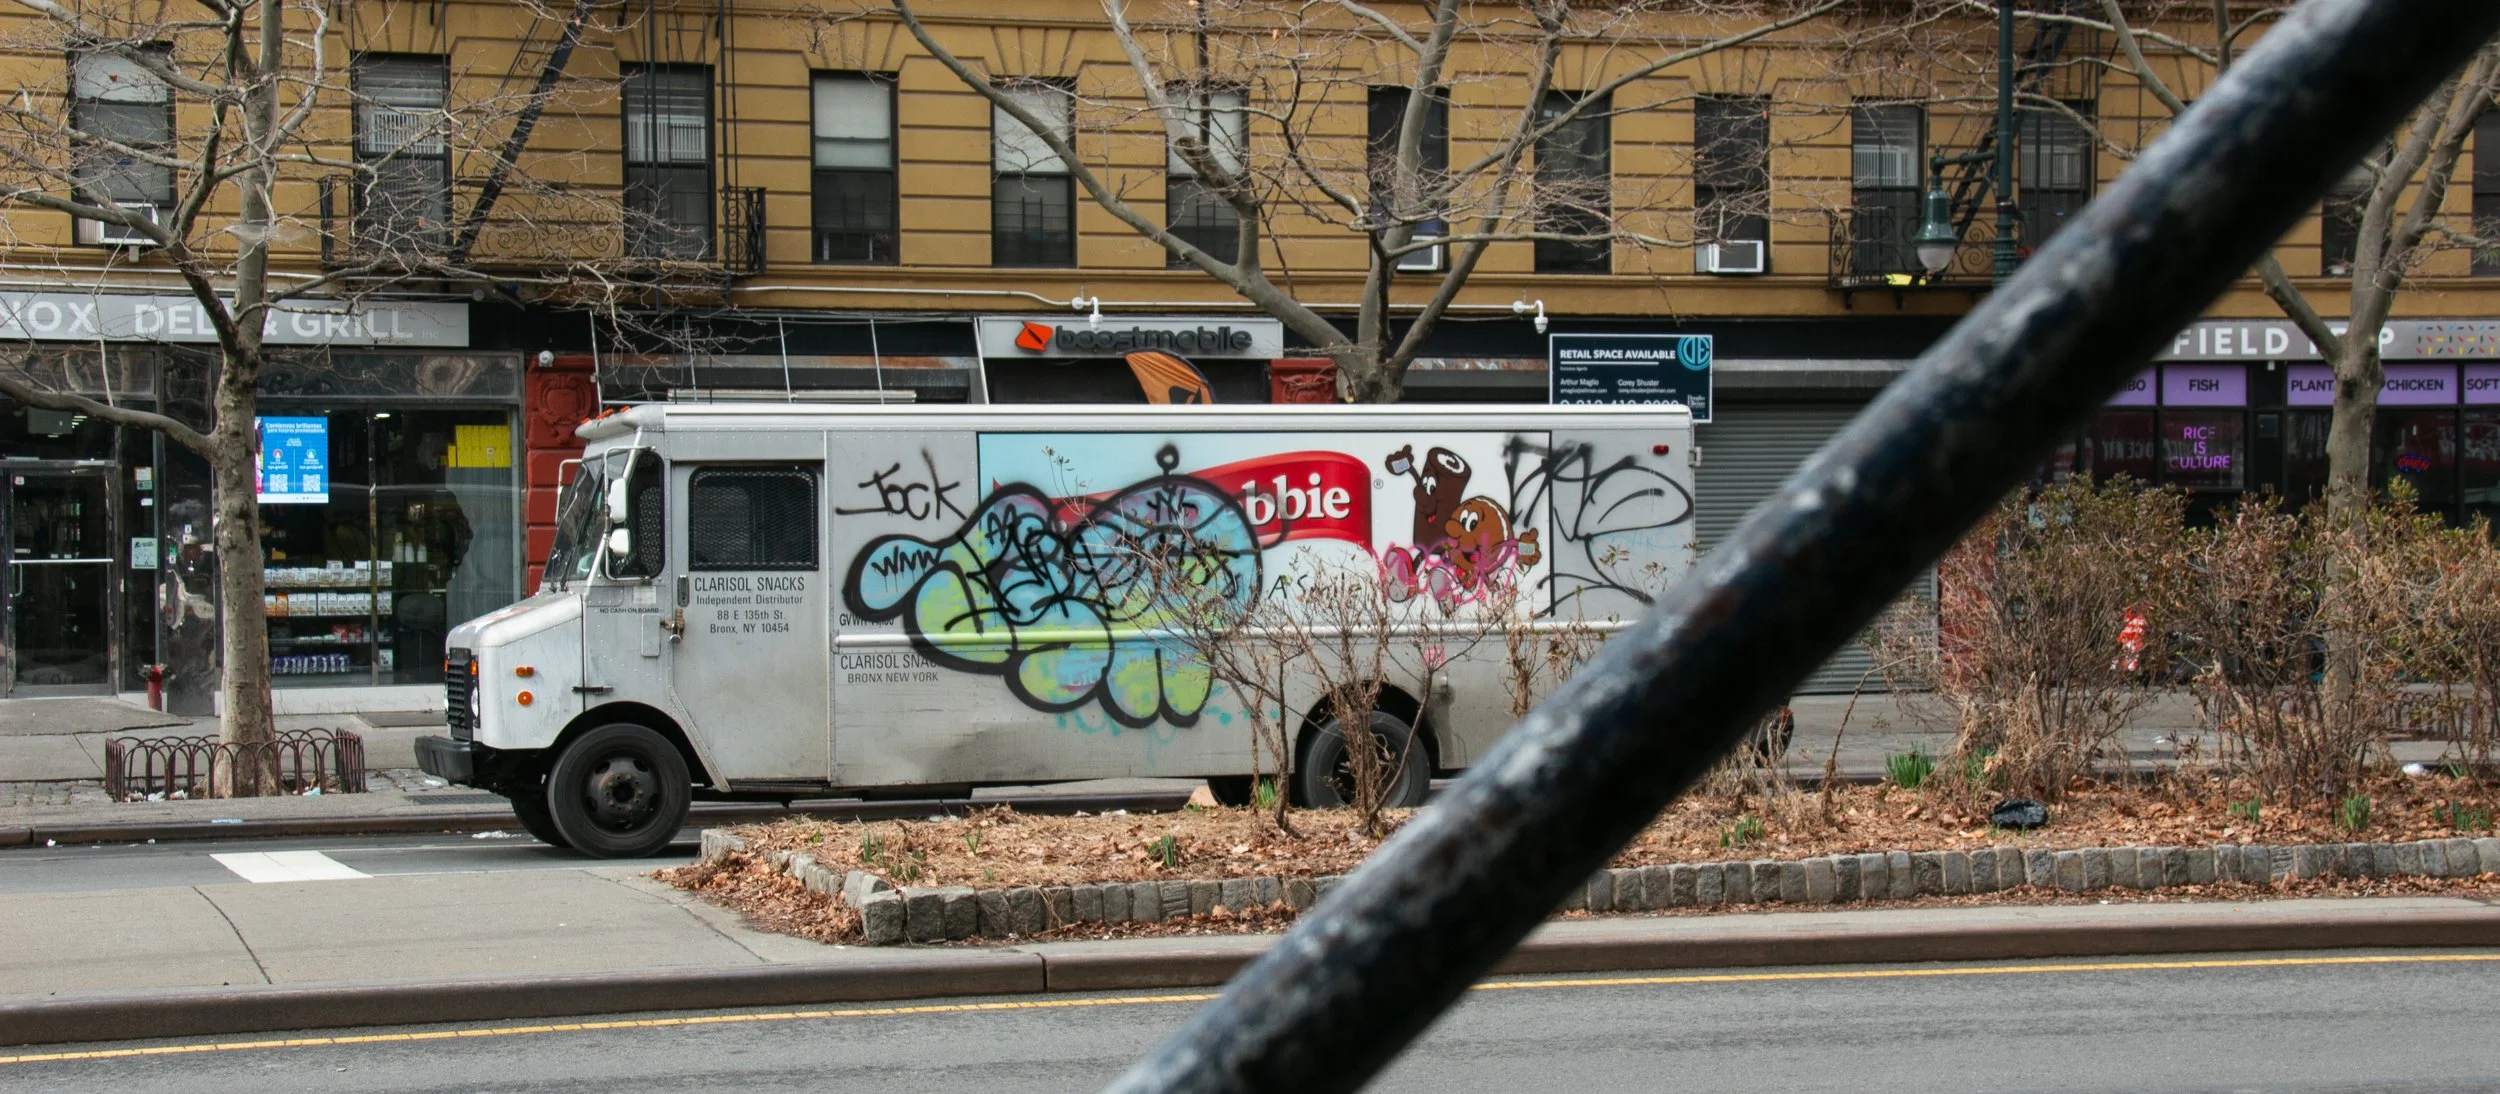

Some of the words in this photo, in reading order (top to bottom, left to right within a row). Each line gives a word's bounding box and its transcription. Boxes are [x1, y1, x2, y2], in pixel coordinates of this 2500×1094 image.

[135, 304, 219, 335] DEL
[291, 309, 413, 338] GRILL
[2173, 327, 2289, 354] FIELD
[1560, 350, 1592, 359] RETAIL
[1593, 350, 1623, 359] SPACE
[1625, 350, 1676, 359] AVAILABLE
[1560, 378, 1579, 386] Arthur
[2189, 379, 2219, 391] FISH
[2291, 380, 2334, 391] PLANT
[2387, 379, 2444, 391] CHICKEN
[2466, 378, 2500, 390] SOFT
[2183, 426, 2216, 440] RICE
[2193, 441, 2206, 455] IS
[2169, 455, 2231, 469] CULTURE
[1241, 472, 1351, 526] bbie
[694, 576, 752, 592] CLARISOL
[757, 576, 805, 591] SNACKS
[1268, 575, 1287, 600] A
[696, 595, 752, 606] Independent
[756, 594, 803, 605] Distributor
[717, 610, 729, 620] 88
[733, 610, 740, 620] E
[745, 609, 769, 620] 135th
[773, 609, 786, 620] St.
[710, 623, 739, 635] Bronx,
[743, 623, 757, 633] NY
[761, 622, 789, 633] 10454
[840, 654, 899, 670] CLARISOL
[847, 673, 883, 683] BRONX
[886, 673, 910, 683] NEW
[913, 672, 939, 682] YORK
